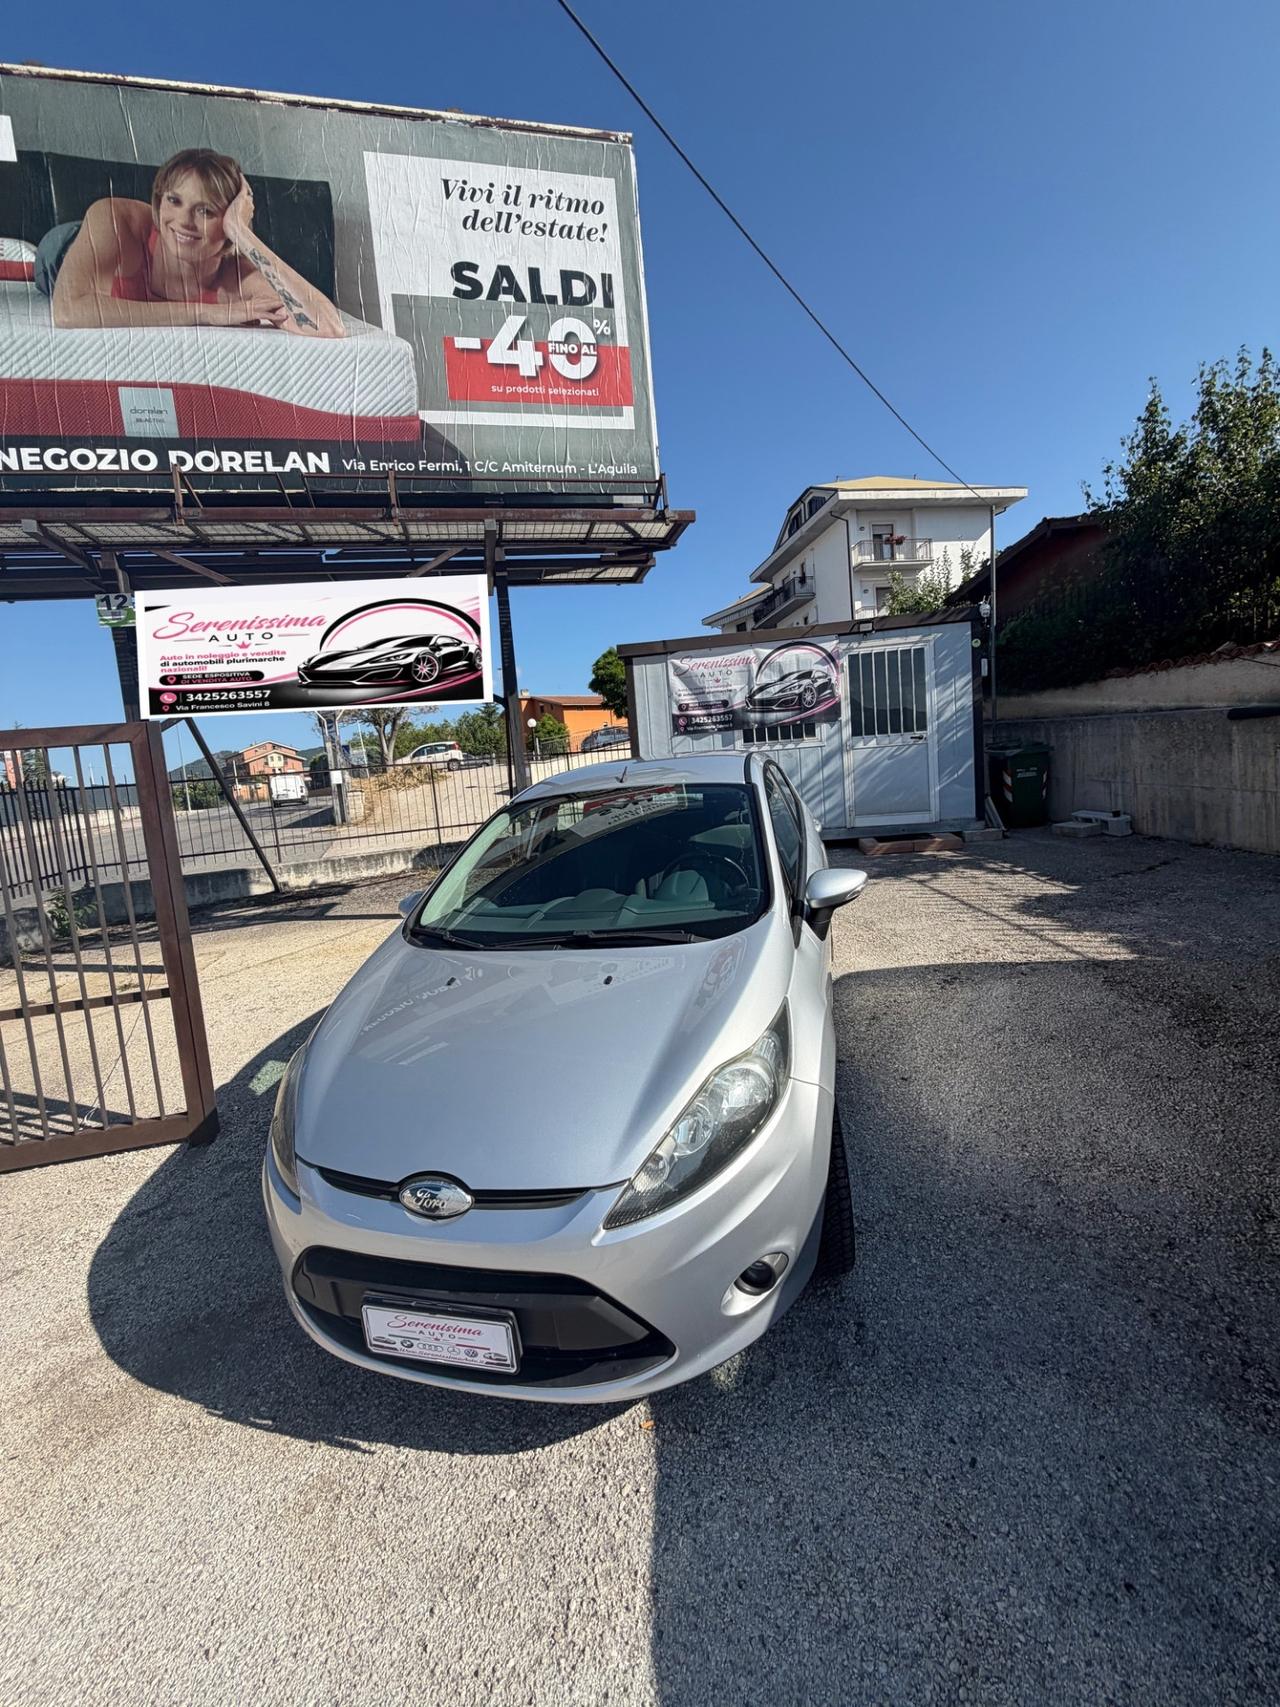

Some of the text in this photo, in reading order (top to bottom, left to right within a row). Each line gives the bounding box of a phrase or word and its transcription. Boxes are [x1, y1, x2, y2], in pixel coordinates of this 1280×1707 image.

[441, 178, 605, 216] Vivi il ritmo
[450, 261, 615, 309] SALDI
[548, 343, 597, 355] FINO AL
[505, 384, 545, 395] prodotti
[549, 387, 599, 397] selezionati
[0, 447, 330, 473] NEGOZIO DORELAN
[342, 459, 367, 471] Via
[370, 460, 415, 472] Enrico
[418, 460, 462, 474] Fermi,
[465, 461, 471, 472] 1
[475, 460, 498, 473] C/C
[501, 461, 577, 474] Amiternum
[100, 594, 129, 610] 12
[153, 612, 327, 639] Serenissima
[208, 632, 273, 642] AUTO
[172, 658, 224, 666] automobili
[226, 656, 285, 664] plurimarche
[197, 652, 239, 661] noleggio
[673, 655, 758, 676] Serenissima
[700, 669, 733, 678] AUTO
[186, 690, 271, 702] 3425263557
[413, 1188, 450, 1209] Ford
[419, 1330, 456, 1339] AUTO
